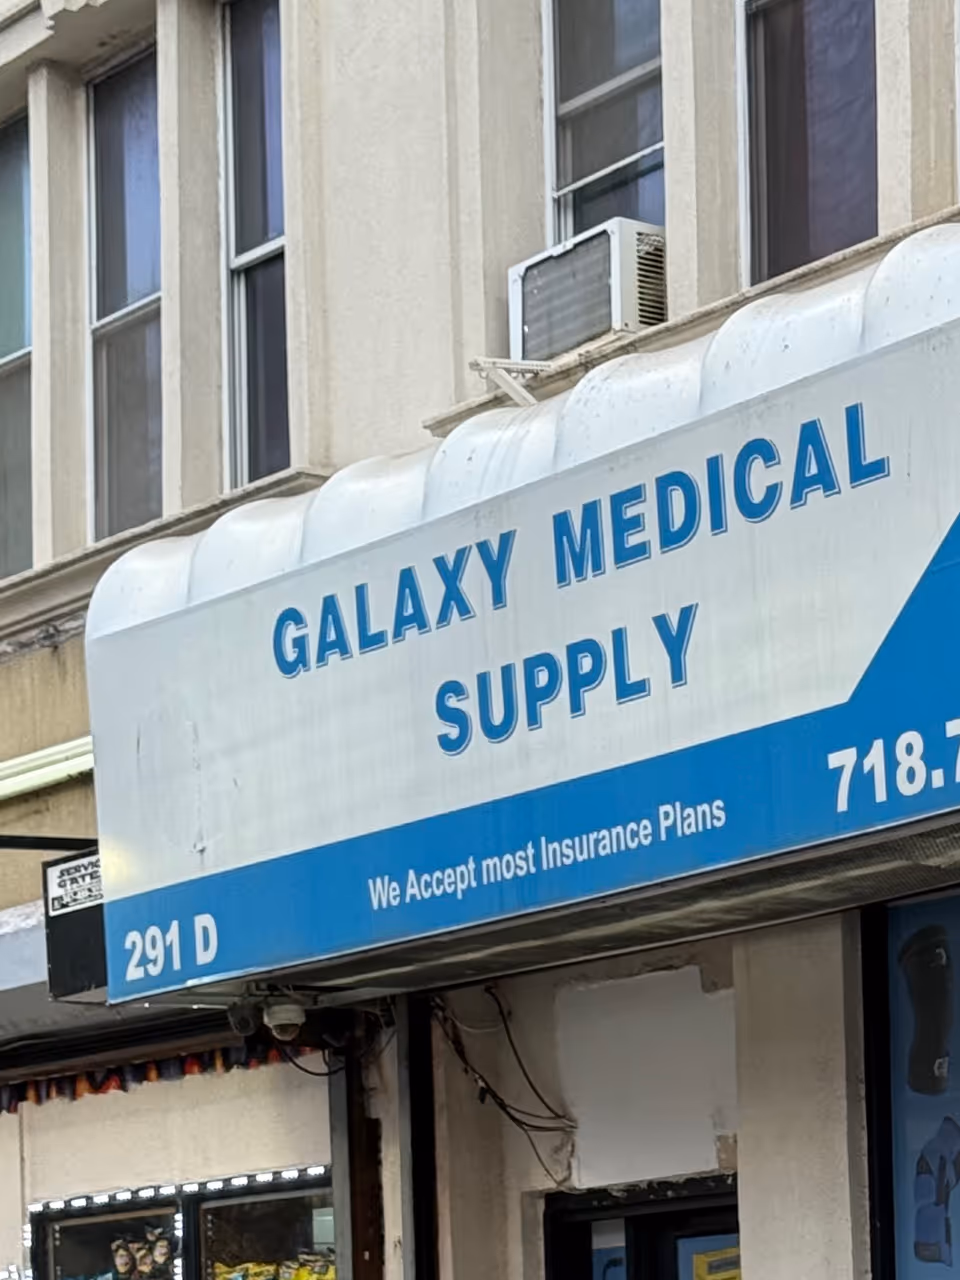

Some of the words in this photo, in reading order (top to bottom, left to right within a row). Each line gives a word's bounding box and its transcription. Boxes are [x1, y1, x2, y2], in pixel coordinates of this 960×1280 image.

[272, 529, 518, 679] GALAXY
[552, 401, 891, 588] MEDICAL
[435, 602, 699, 756] SUPPLY
[368, 875, 400, 910] We
[405, 856, 477, 903] Accept
[482, 841, 536, 885] most
[541, 818, 652, 870] Insurance
[659, 799, 726, 841] Plans
[124, 919, 182, 981] 291
[194, 912, 218, 966] D
